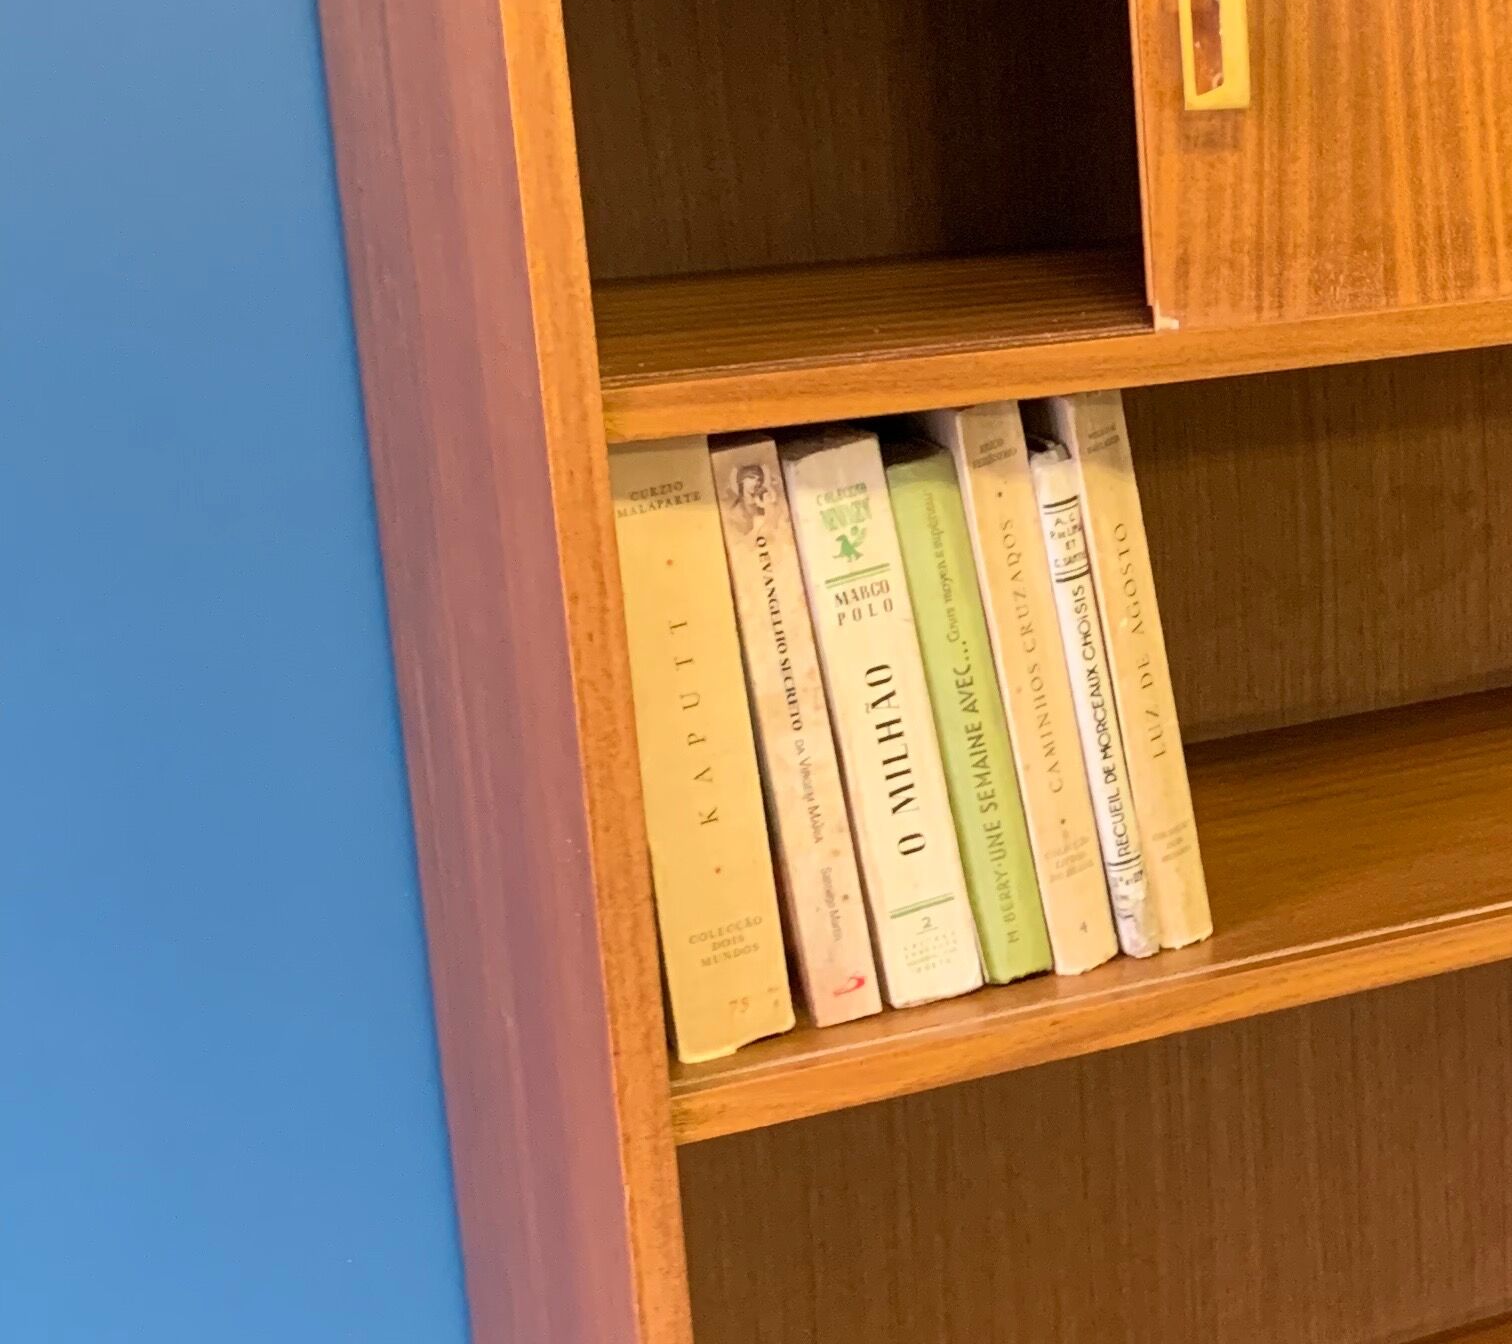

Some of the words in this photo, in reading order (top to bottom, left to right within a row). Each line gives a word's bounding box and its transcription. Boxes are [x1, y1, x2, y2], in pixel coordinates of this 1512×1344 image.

[617, 491, 701, 518] MALAPARTE
[630, 481, 684, 501] CURZIO
[757, 536, 767, 548] O
[759, 551, 788, 655] EVANGELHO
[834, 579, 890, 608] MARCO
[1002, 519, 1036, 654] CRUZADOS
[1114, 523, 1145, 634] AGOSTO
[837, 597, 894, 627] POLO
[1072, 585, 1097, 661] CHOISIS
[780, 657, 803, 732] SECRETO
[1138, 653, 1153, 689] DE
[865, 663, 920, 817] MILHÃO
[1027, 662, 1064, 794] CAMINHOS
[1086, 664, 1113, 761] MORCEAUX
[1145, 703, 1167, 760] LUZ
[964, 721, 998, 814] SEMAINE
[1103, 763, 1118, 785] DE
[897, 832, 926, 856] O
[1107, 787, 1131, 858] RECUEIL
[921, 916, 933, 929] 2
[701, 943, 760, 967] MUNDOS
